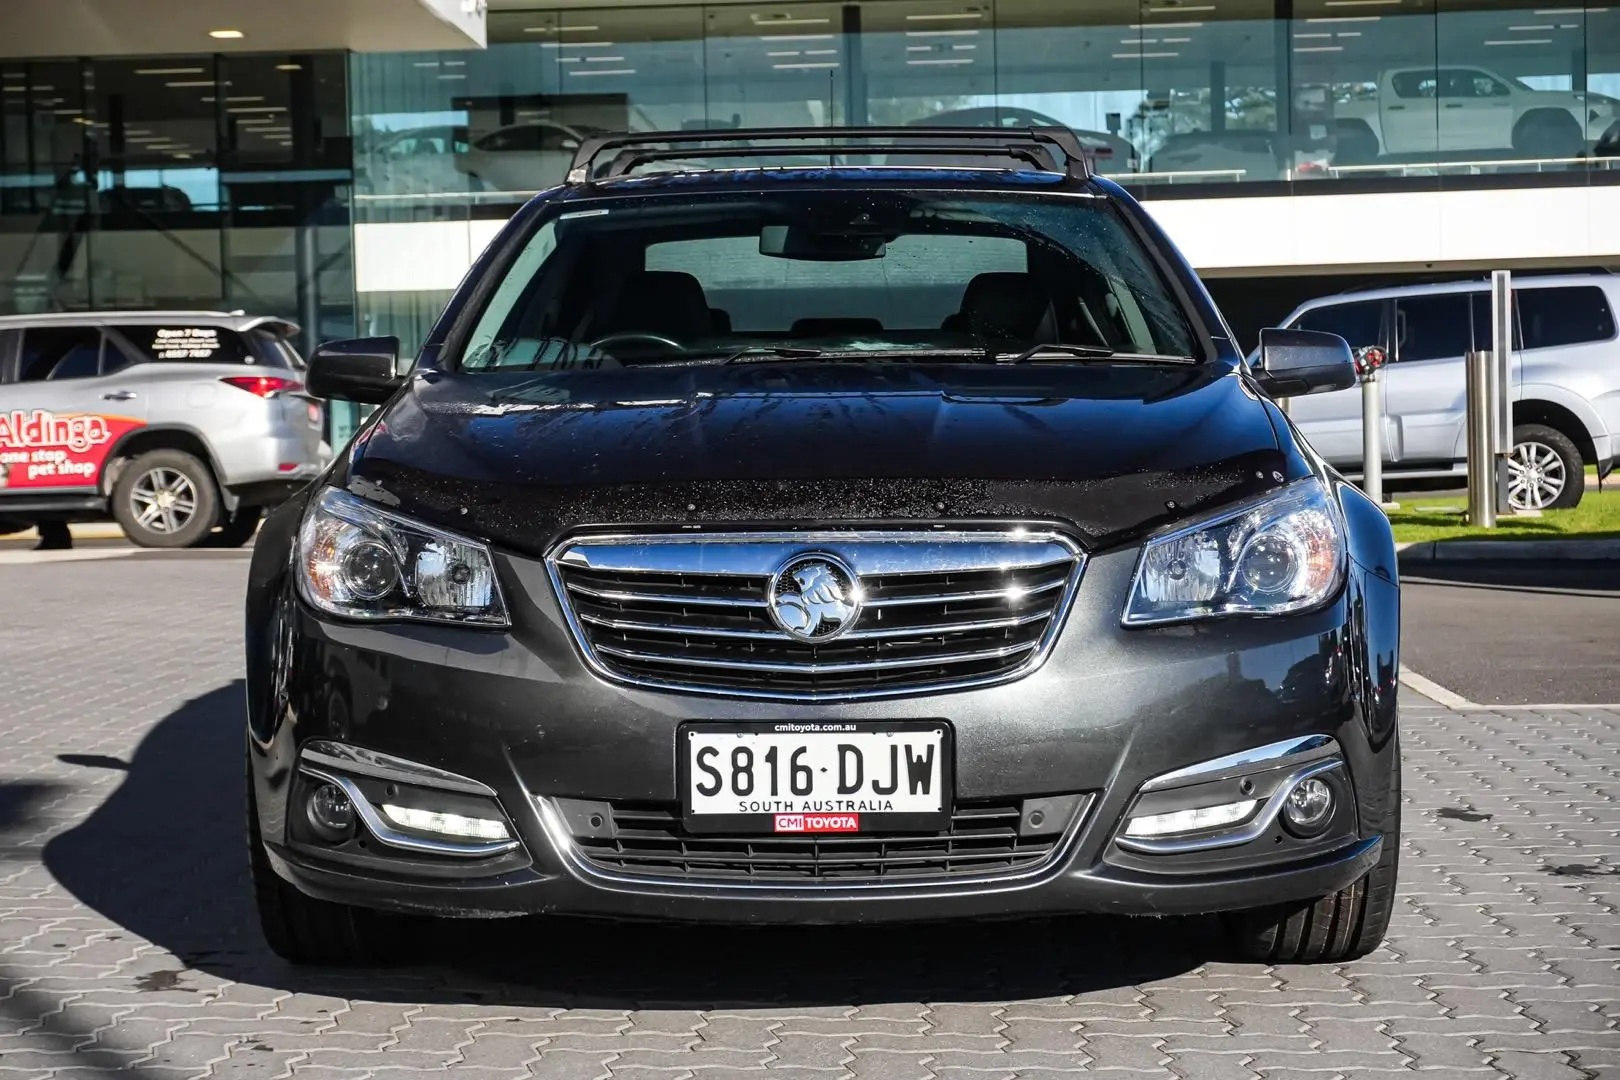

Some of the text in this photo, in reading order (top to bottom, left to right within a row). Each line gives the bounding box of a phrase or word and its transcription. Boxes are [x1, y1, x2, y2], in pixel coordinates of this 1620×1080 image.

[0, 409, 112, 453] Aldinga
[0, 449, 67, 465] one stop
[28, 459, 96, 480] pet shop
[774, 723, 857, 734] cmitoyota.com.au
[738, 799, 893, 813] SOUTH AUSTRALIA
[778, 816, 857, 829] CMI TOYOTA
